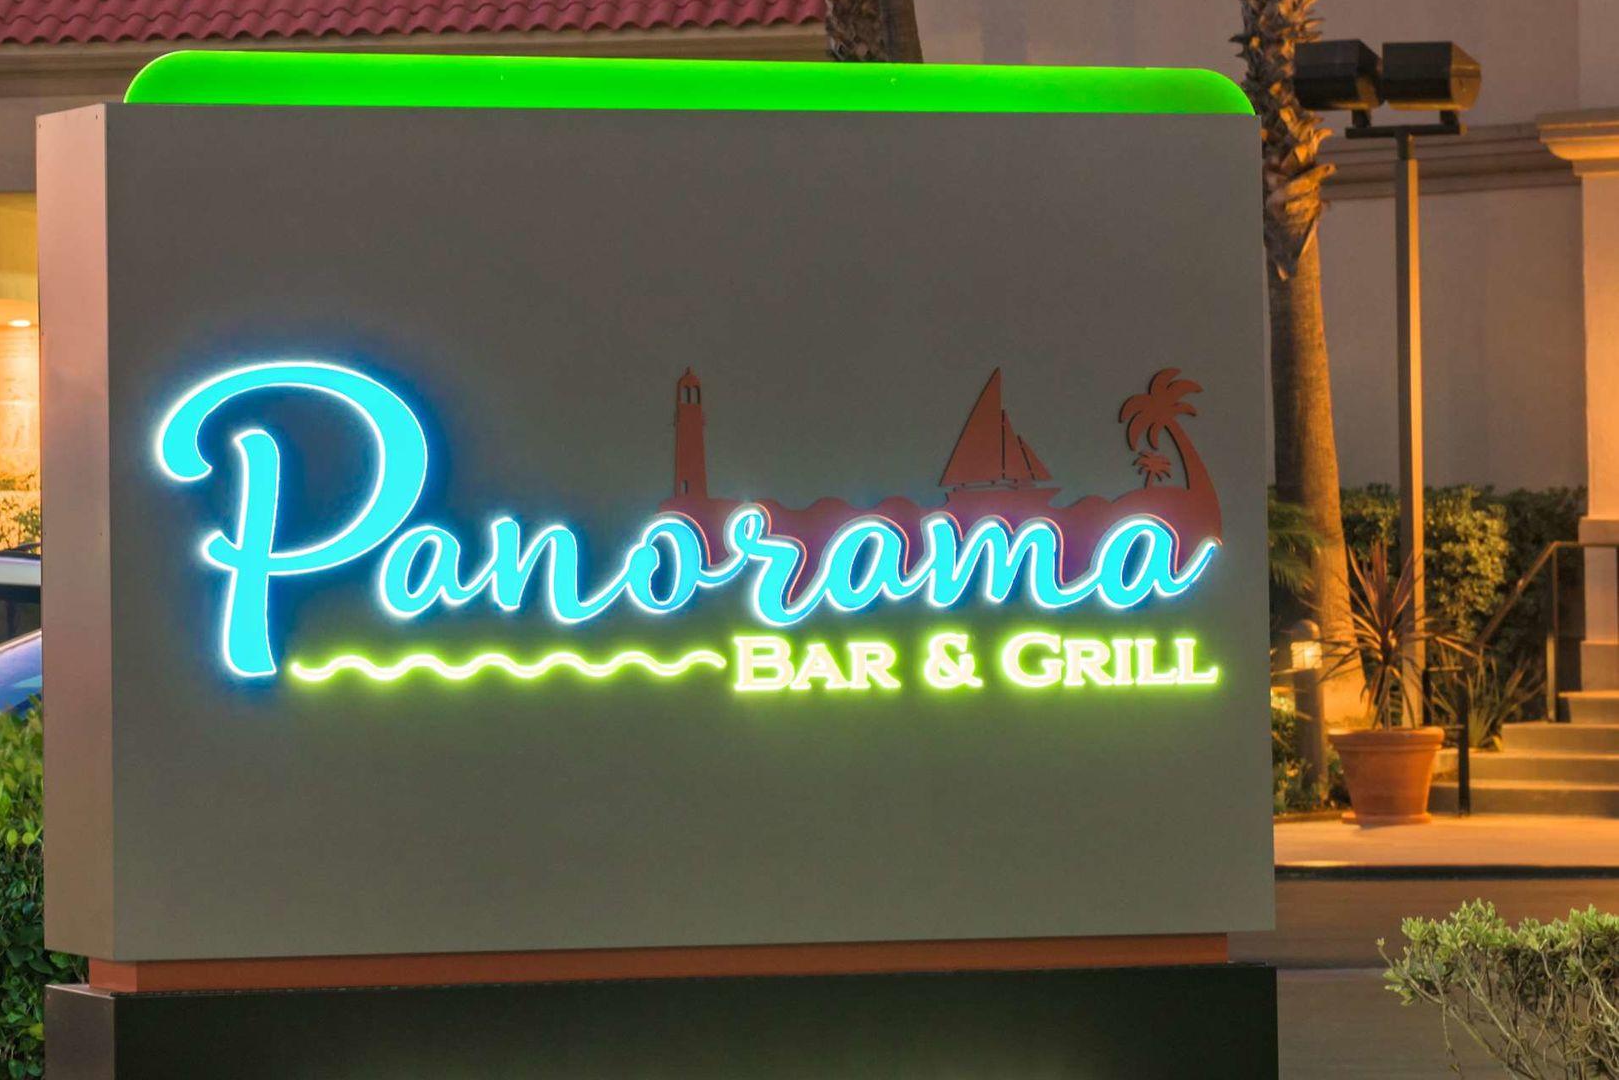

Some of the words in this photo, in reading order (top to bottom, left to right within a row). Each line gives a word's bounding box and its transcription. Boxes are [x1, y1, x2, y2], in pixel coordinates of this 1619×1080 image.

[153, 359, 1220, 680] Panorama
[732, 633, 901, 692] BAR
[922, 631, 982, 691] &
[1000, 631, 1222, 688] GRILL
